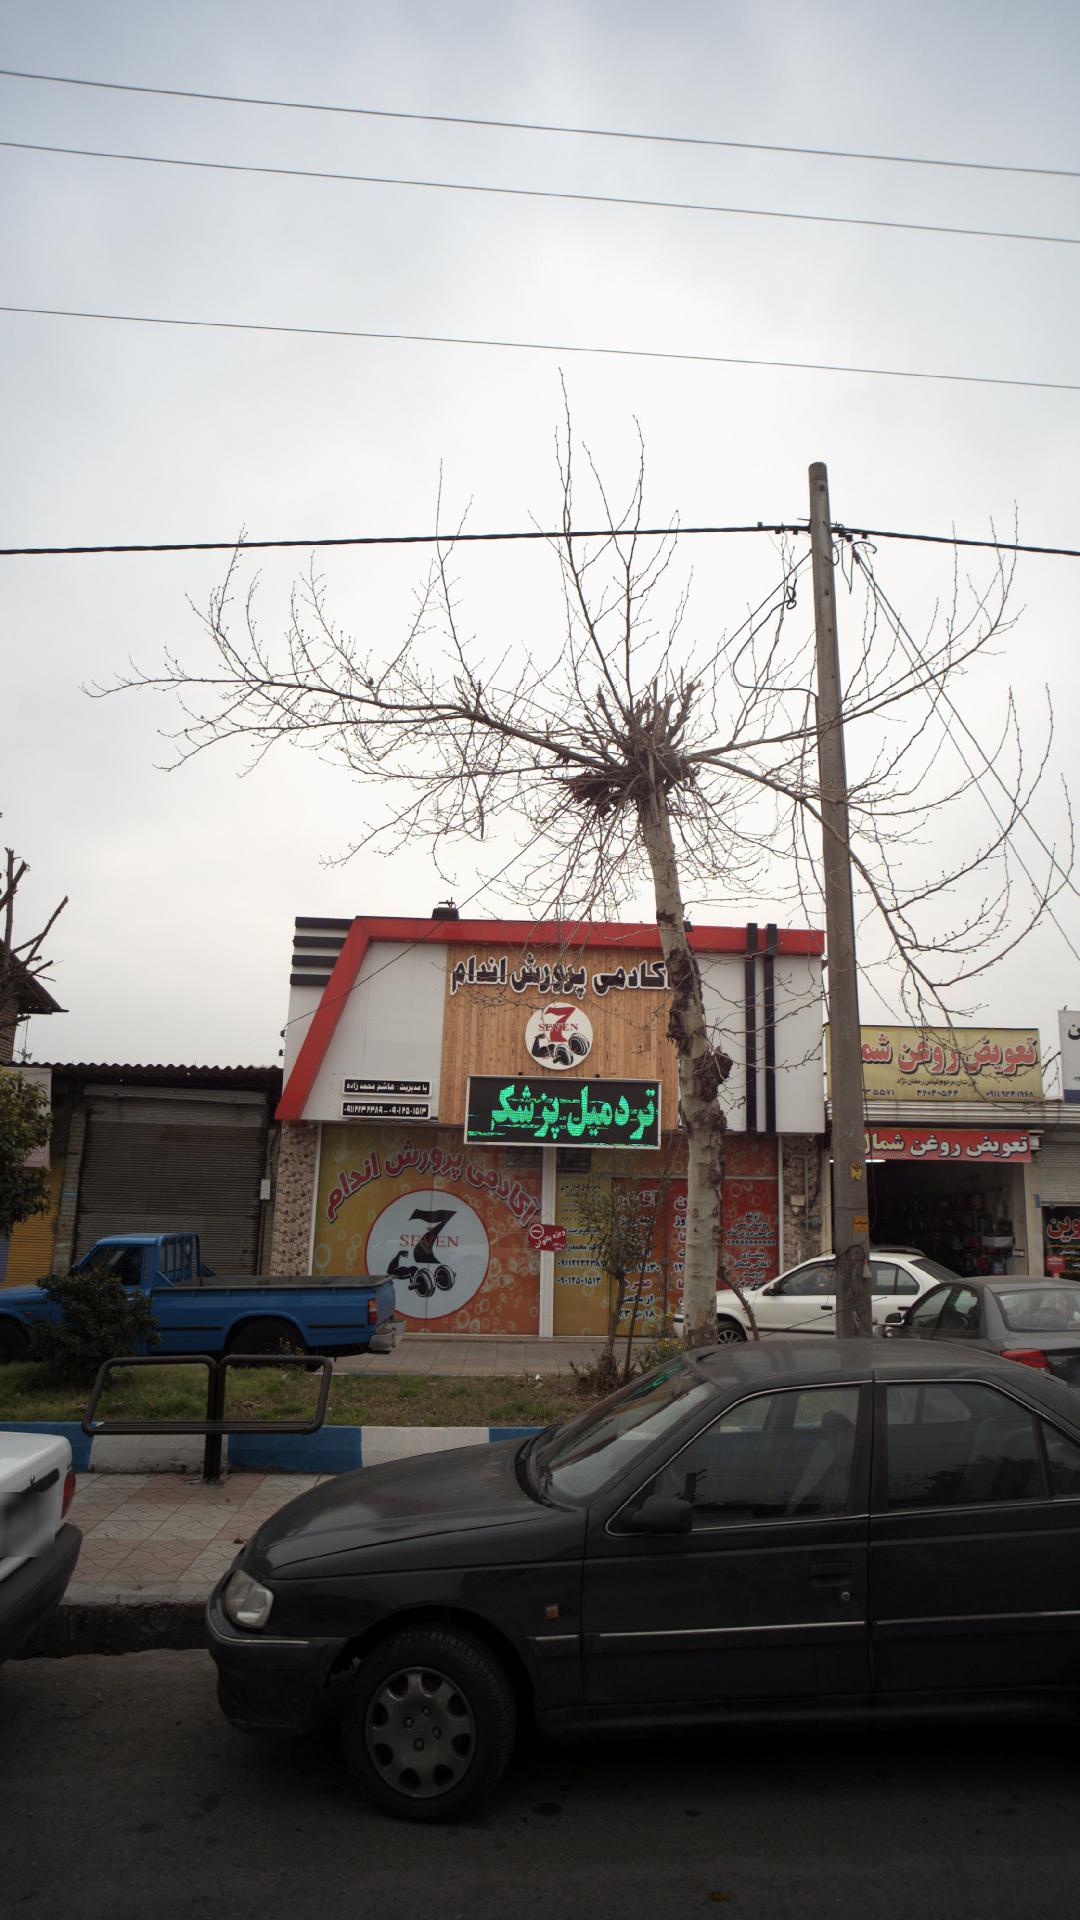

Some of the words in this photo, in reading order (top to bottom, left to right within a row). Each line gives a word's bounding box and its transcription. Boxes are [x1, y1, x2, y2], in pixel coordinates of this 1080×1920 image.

[449, 955, 508, 996] اندام
[510, 952, 587, 1000] پرورش
[538, 1023, 579, 1032] SEVEN
[861, 1031, 892, 1064] شم
[897, 1033, 960, 1076] روغن
[964, 1034, 1038, 1076] تعویض
[377, 1082, 395, 1093] هاشم
[491, 1083, 560, 1140] پزشک
[384, 1139, 464, 1180] پرورش
[910, 1133, 961, 1157] روغن
[966, 1133, 1029, 1158] تعویض
[326, 1149, 380, 1223] اندام
[466, 1163, 541, 1227] آکادمی
[399, 1234, 460, 1248] SEVEN
[557, 1258, 604, 1267] ۰۹۱۱۲۲۳۲۳۸
